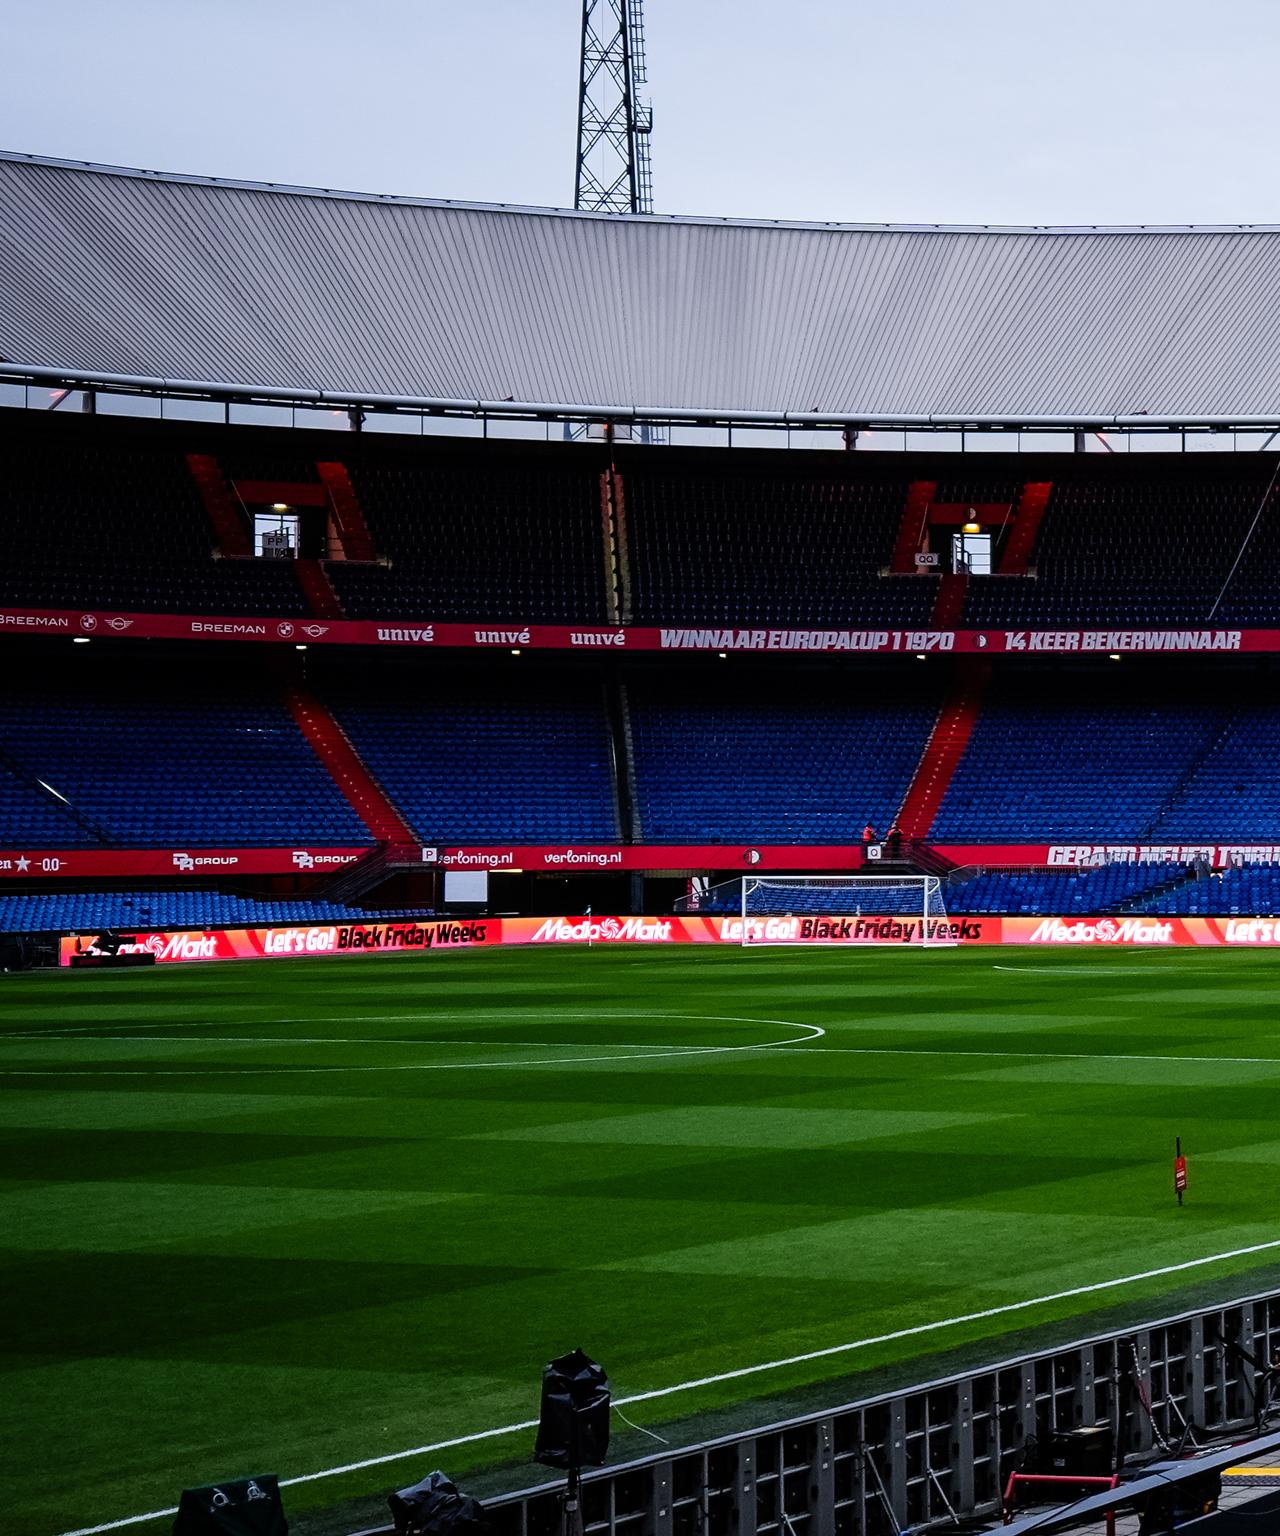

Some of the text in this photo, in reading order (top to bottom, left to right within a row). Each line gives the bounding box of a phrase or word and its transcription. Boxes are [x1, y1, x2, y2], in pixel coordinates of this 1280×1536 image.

[191, 622, 265, 634] BREEMAN
[377, 625, 434, 642] univé
[474, 627, 530, 644] univé
[570, 629, 625, 645] univé
[660, 629, 955, 650] WINNAAR EUROPACUP 1 1970
[1005, 631, 1242, 651] 14 KEER BEKERWINNAAR
[194, 857, 239, 865] GROUP
[544, 850, 622, 866] verloning.nl
[1047, 846, 1138, 867] GERARD
[263, 923, 488, 953] Let's Go! Black Friday Weeks
[719, 917, 982, 943] Let's Go! Black Friday Weeks
[1224, 919, 1273, 942] Let's
